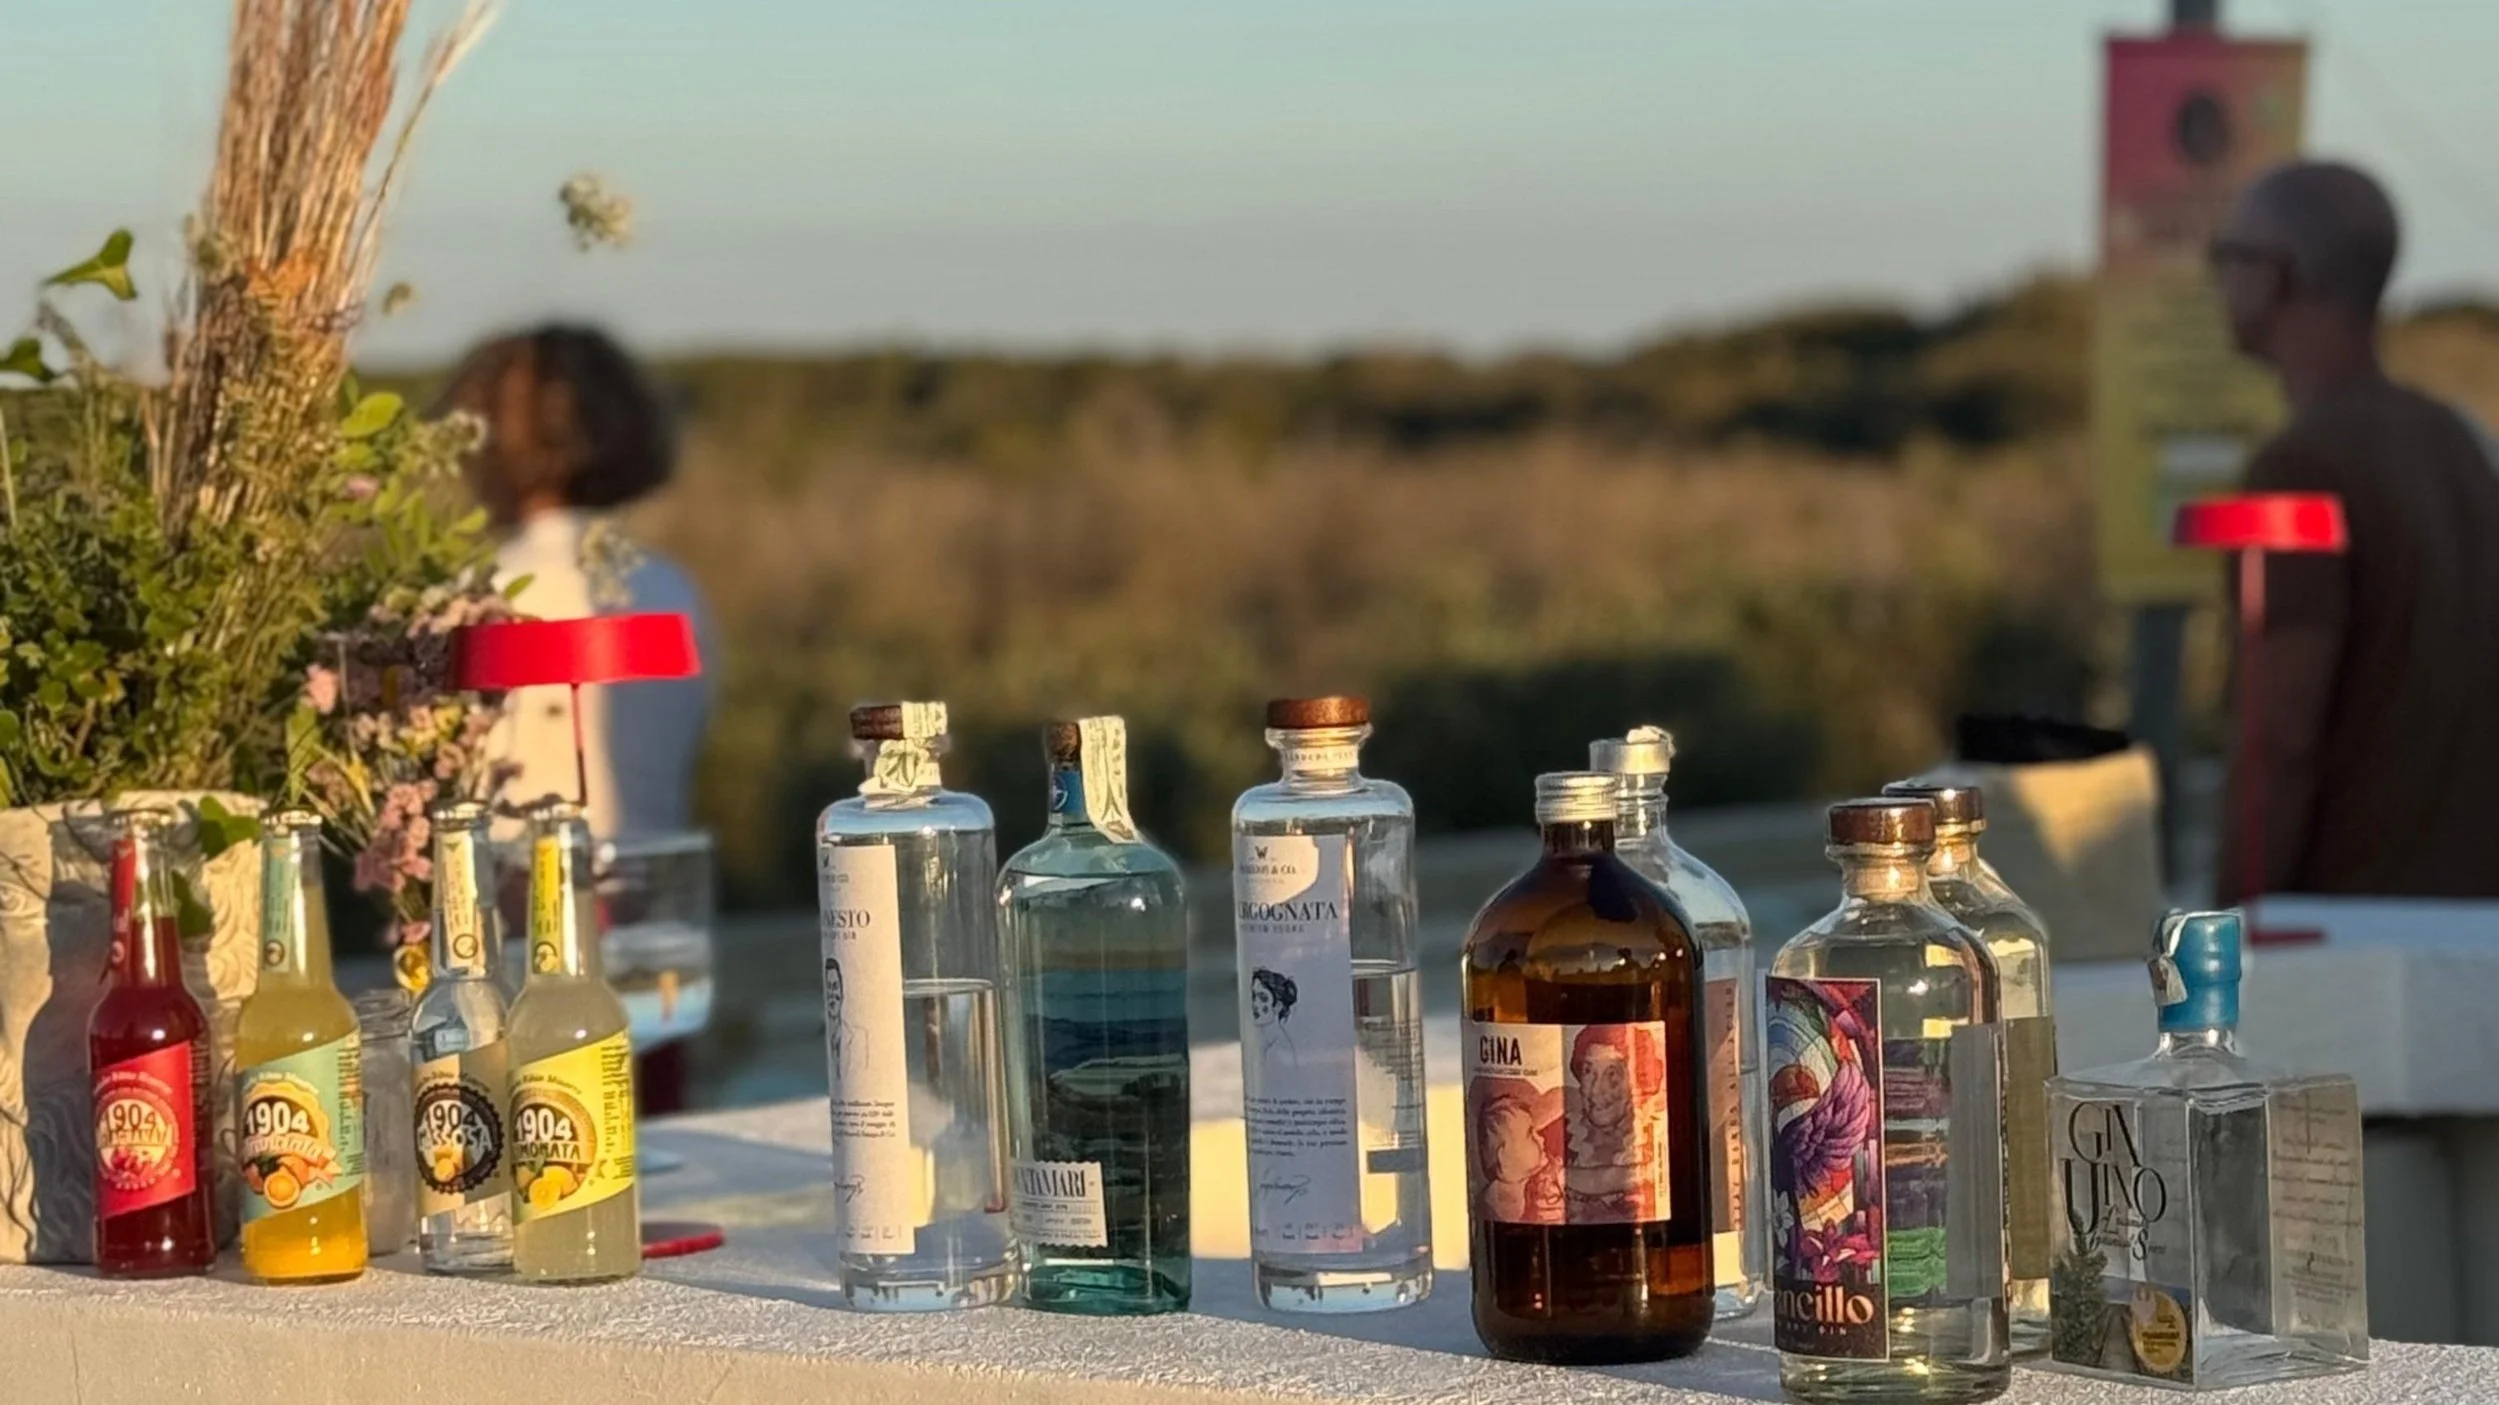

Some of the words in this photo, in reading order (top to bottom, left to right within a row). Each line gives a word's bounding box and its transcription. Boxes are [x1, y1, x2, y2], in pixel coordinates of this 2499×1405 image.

[1480, 1035, 1523, 1066] GINA
[105, 1103, 157, 1134] 1904
[246, 1101, 310, 1136] 1904
[425, 1104, 477, 1132] 1904
[516, 1107, 574, 1141] 1904
